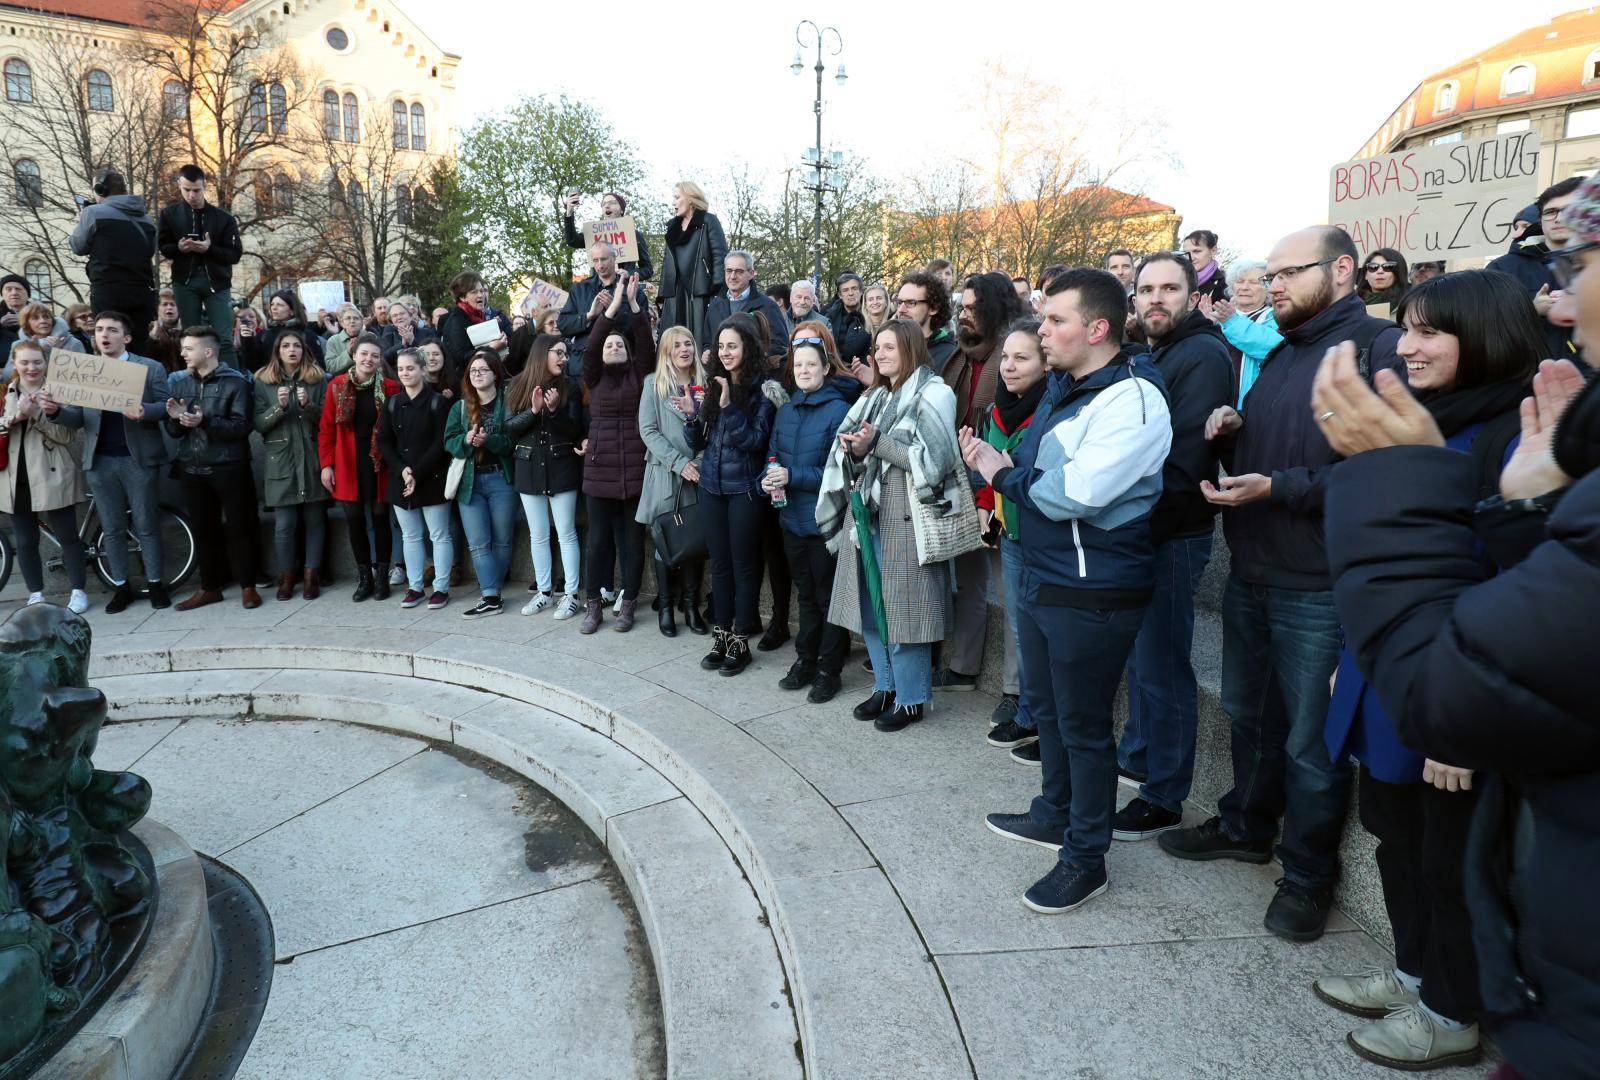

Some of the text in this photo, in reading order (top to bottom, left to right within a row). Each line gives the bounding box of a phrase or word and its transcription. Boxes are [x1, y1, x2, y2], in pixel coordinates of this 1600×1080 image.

[1335, 153, 1419, 202] BORAS
[1424, 169, 1444, 188] na
[592, 221, 619, 233] SUMMA
[1425, 232, 1441, 251] u
[54, 354, 105, 375] OVAJ
[57, 369, 123, 387] KARTON
